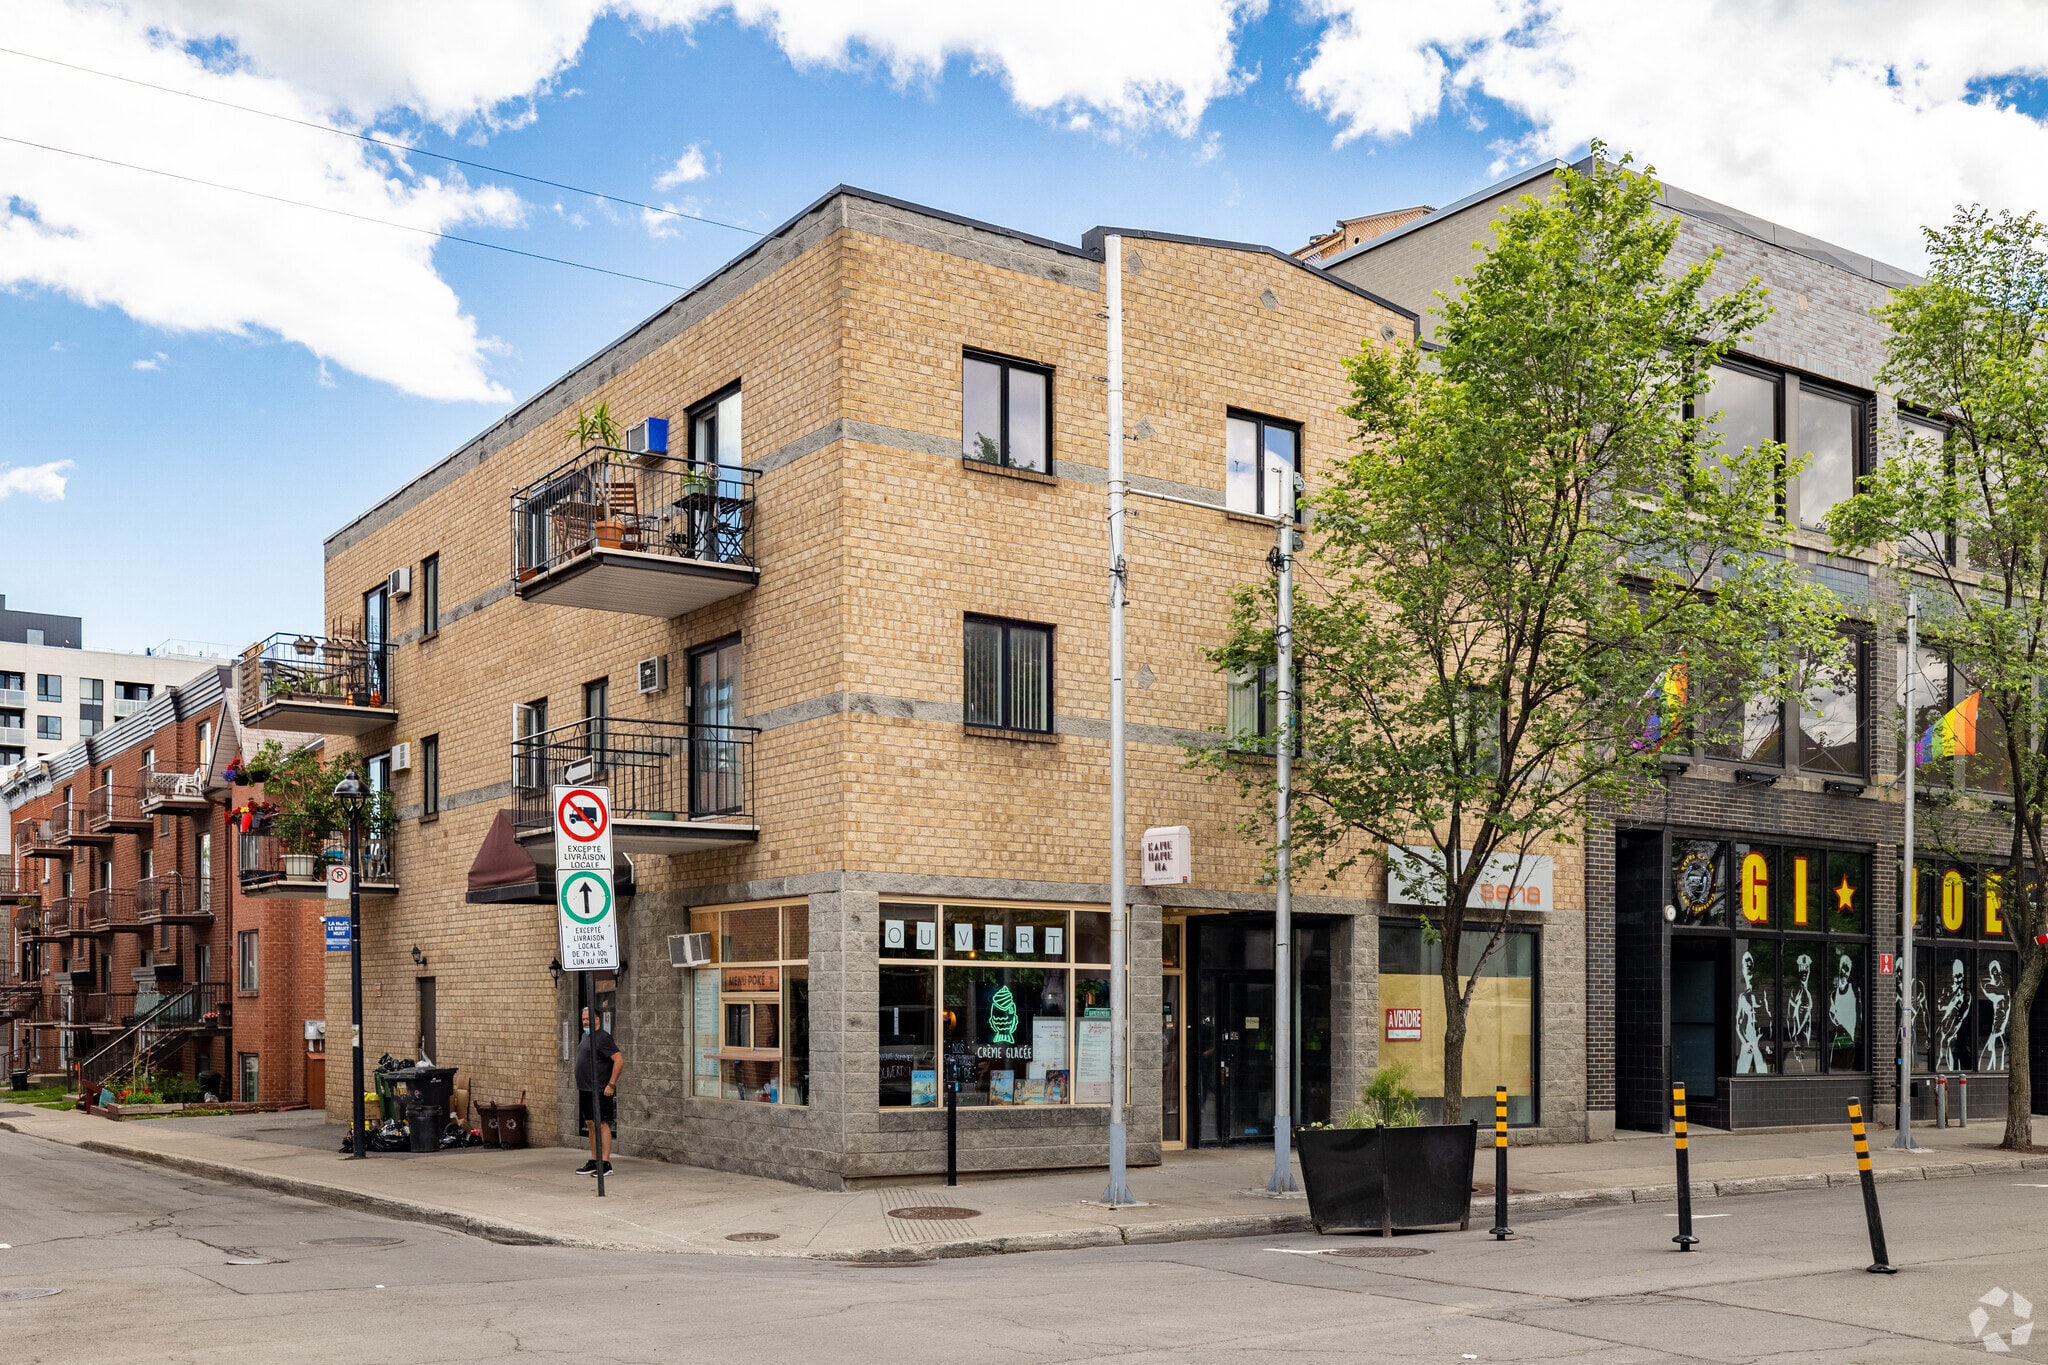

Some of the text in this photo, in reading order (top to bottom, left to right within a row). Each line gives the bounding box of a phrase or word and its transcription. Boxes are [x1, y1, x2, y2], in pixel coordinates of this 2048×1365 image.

[1148, 841, 1173, 852] KAME
[1148, 851, 1173, 862] HAME
[1154, 862, 1167, 872] HA
[1480, 884, 1540, 904] sena
[1741, 851, 1809, 926] GI
[575, 926, 601, 934] EXCEPTÉ
[888, 927, 1060, 953] OUVERT
[728, 972, 765, 986] MENU POKÉ
[1388, 1010, 1421, 1027] À VENDRE
[977, 1044, 1002, 1059] CRÈME
[1005, 1044, 1032, 1059] GLACÉE
